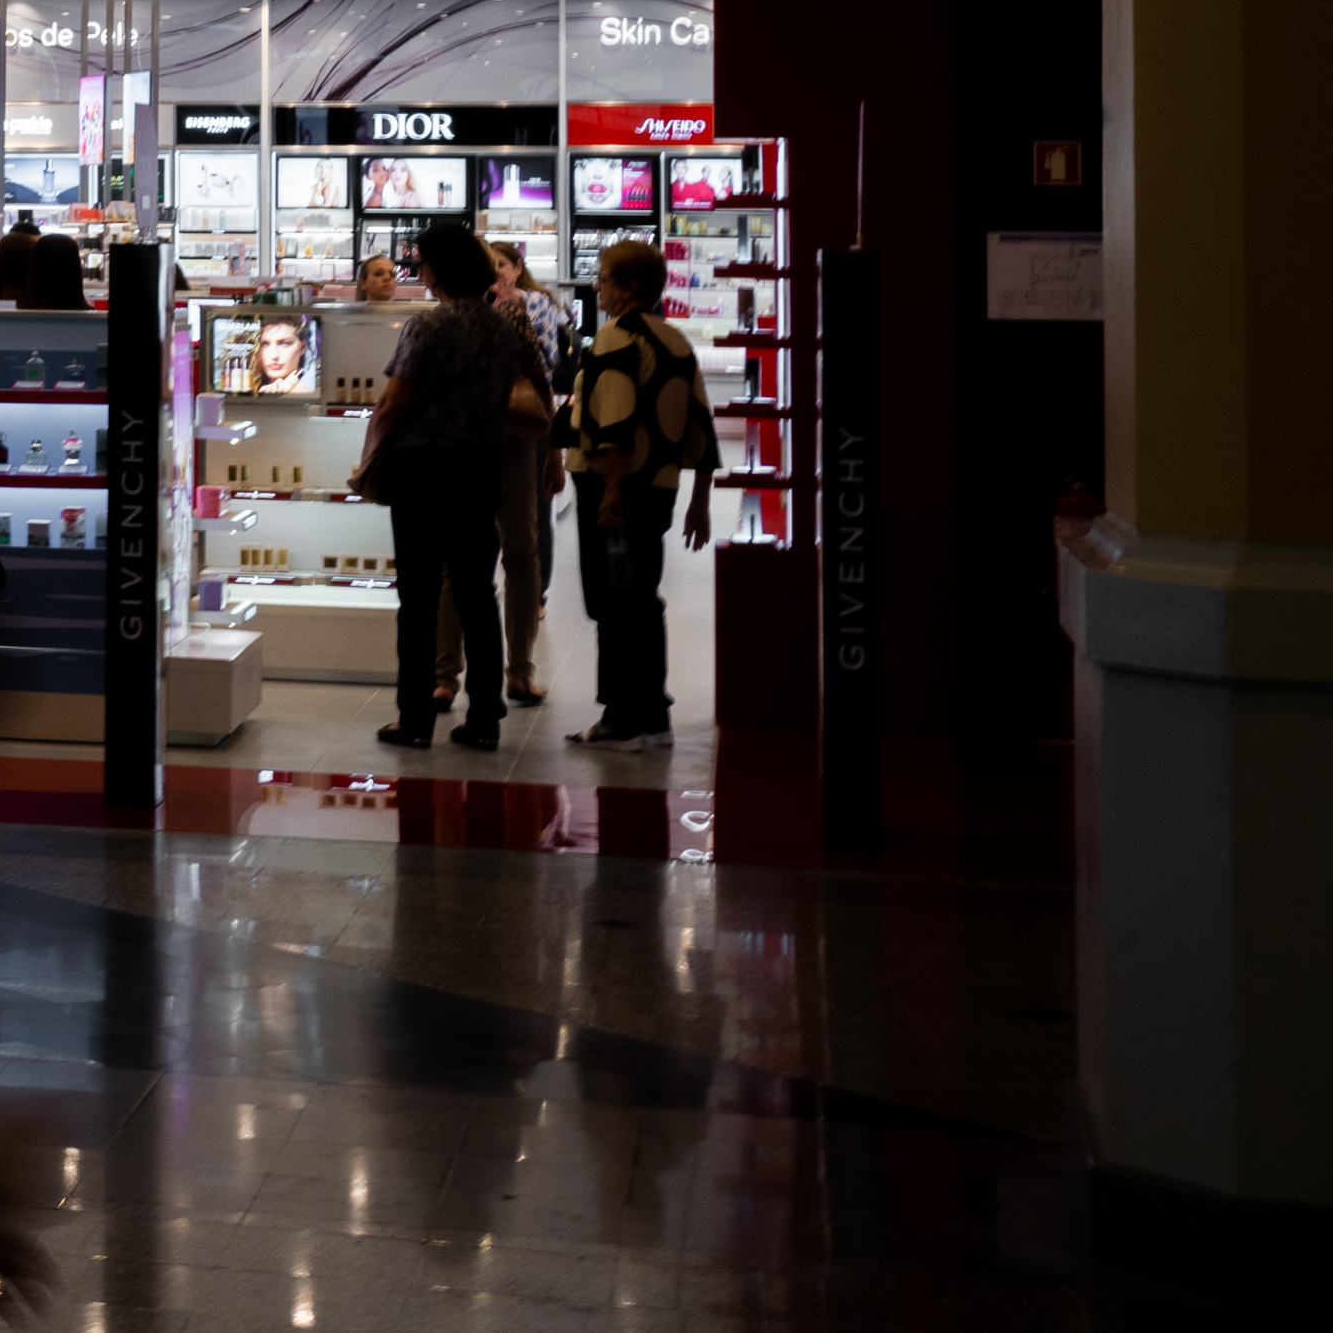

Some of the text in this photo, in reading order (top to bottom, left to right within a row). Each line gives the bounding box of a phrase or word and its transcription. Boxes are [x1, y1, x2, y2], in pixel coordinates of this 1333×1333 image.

[40, 21, 74, 48] de
[599, 16, 662, 46] Skin
[184, 115, 251, 129] EISENBERG
[371, 112, 456, 141] DIOR
[633, 117, 707, 135] SHISEIDO
[119, 408, 145, 641] GIVENCHY
[837, 426, 865, 673] GIVENCHY
